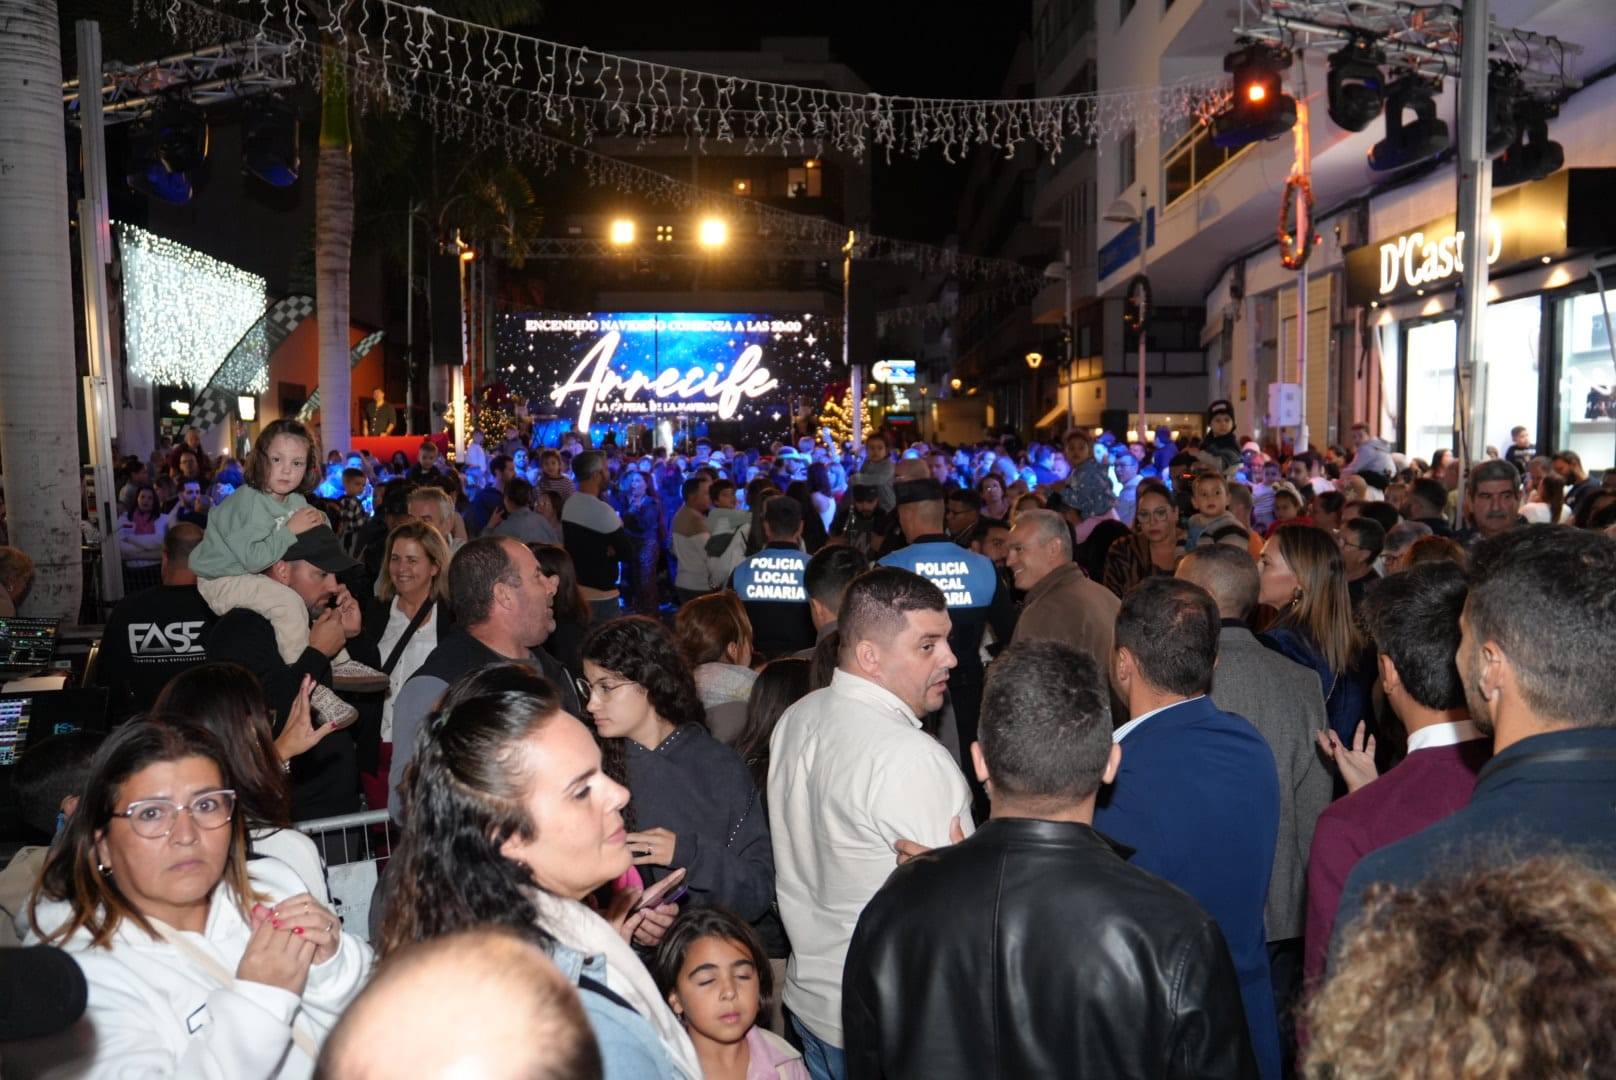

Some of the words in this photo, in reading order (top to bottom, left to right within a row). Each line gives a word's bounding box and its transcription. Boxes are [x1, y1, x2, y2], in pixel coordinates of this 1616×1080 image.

[1380, 219, 1502, 294] D'Casto
[525, 319, 599, 332] ENCENDIDO
[735, 320, 745, 332] A
[747, 320, 770, 332] LAS
[550, 330, 778, 433] Arrecife
[595, 402, 609, 412] LA
[750, 557, 804, 570] POLICIA
[915, 561, 969, 576] POLICIA
[754, 570, 799, 584] LOCAL
[930, 577, 965, 590] OCAL
[746, 584, 806, 600] CANARIA
[943, 591, 973, 605] ARIA
[128, 621, 205, 654] FASE
